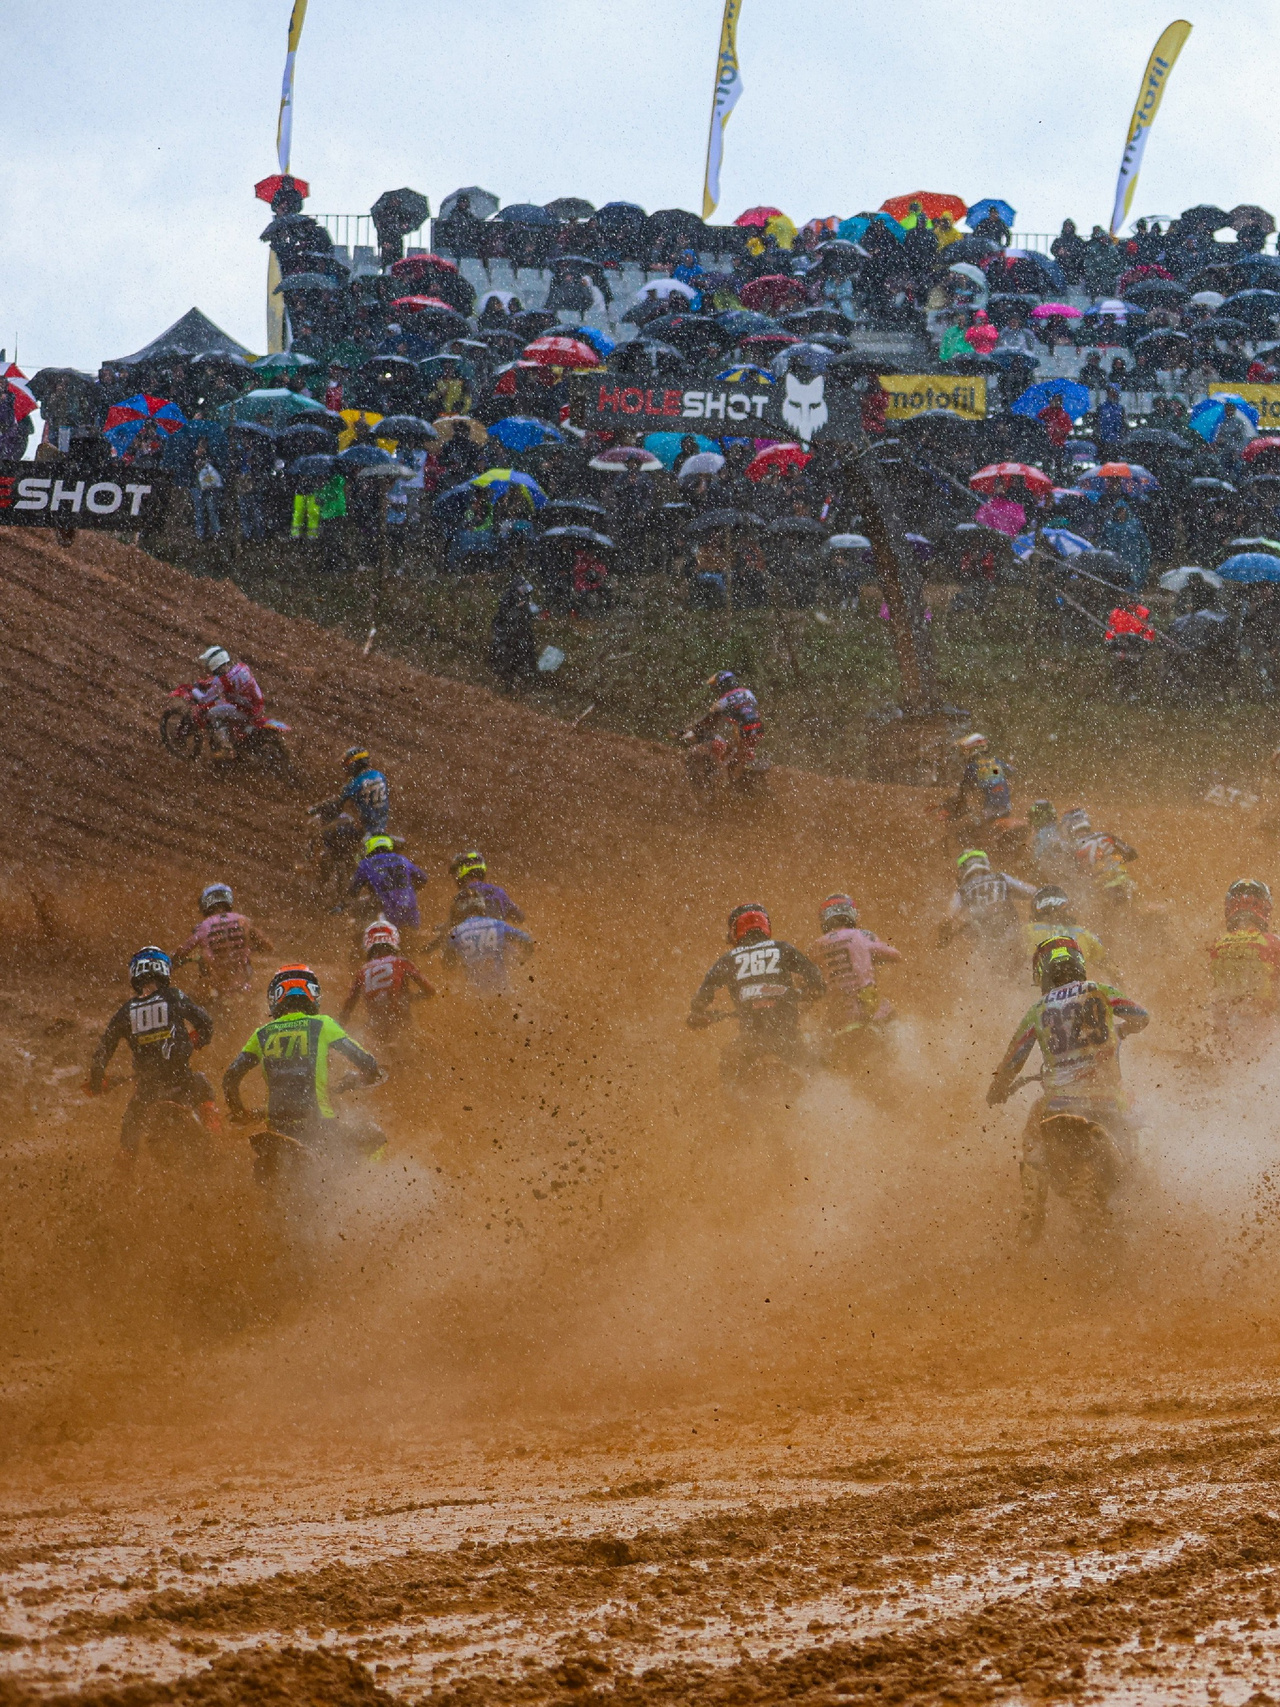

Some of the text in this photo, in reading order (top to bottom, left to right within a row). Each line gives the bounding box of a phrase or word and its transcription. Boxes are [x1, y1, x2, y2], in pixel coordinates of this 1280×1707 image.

[598, 386, 768, 420] HOLESHOT
[365, 963, 394, 992] 12
[735, 949, 781, 981] 262
[130, 1001, 168, 1034] 100
[264, 1031, 308, 1058] 471
